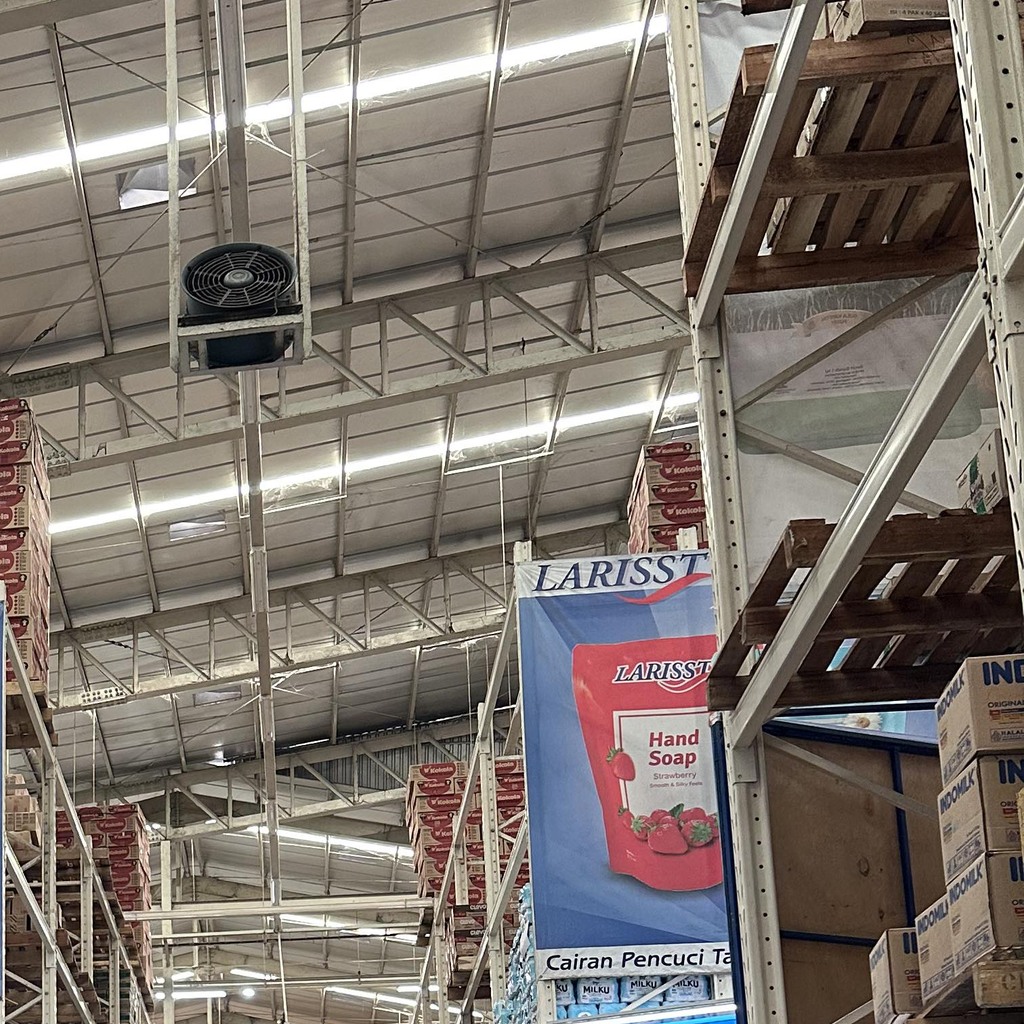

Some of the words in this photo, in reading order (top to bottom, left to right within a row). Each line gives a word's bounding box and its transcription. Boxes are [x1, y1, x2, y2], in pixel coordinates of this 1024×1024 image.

[532, 552, 710, 592] LARISST
[613, 660, 713, 684] LARISST
[649, 729, 699, 747] Hand
[648, 750, 696, 768] Soap
[654, 772, 696, 780] Strawberry
[940, 767, 975, 815] INDOMILK
[948, 861, 984, 906] INDOMILK
[546, 952, 613, 971] Cairan
[621, 949, 705, 969] Pencuci
[713, 948, 733, 965] Ta
[583, 986, 610, 994] MILKU
[631, 980, 657, 988] MILKU
